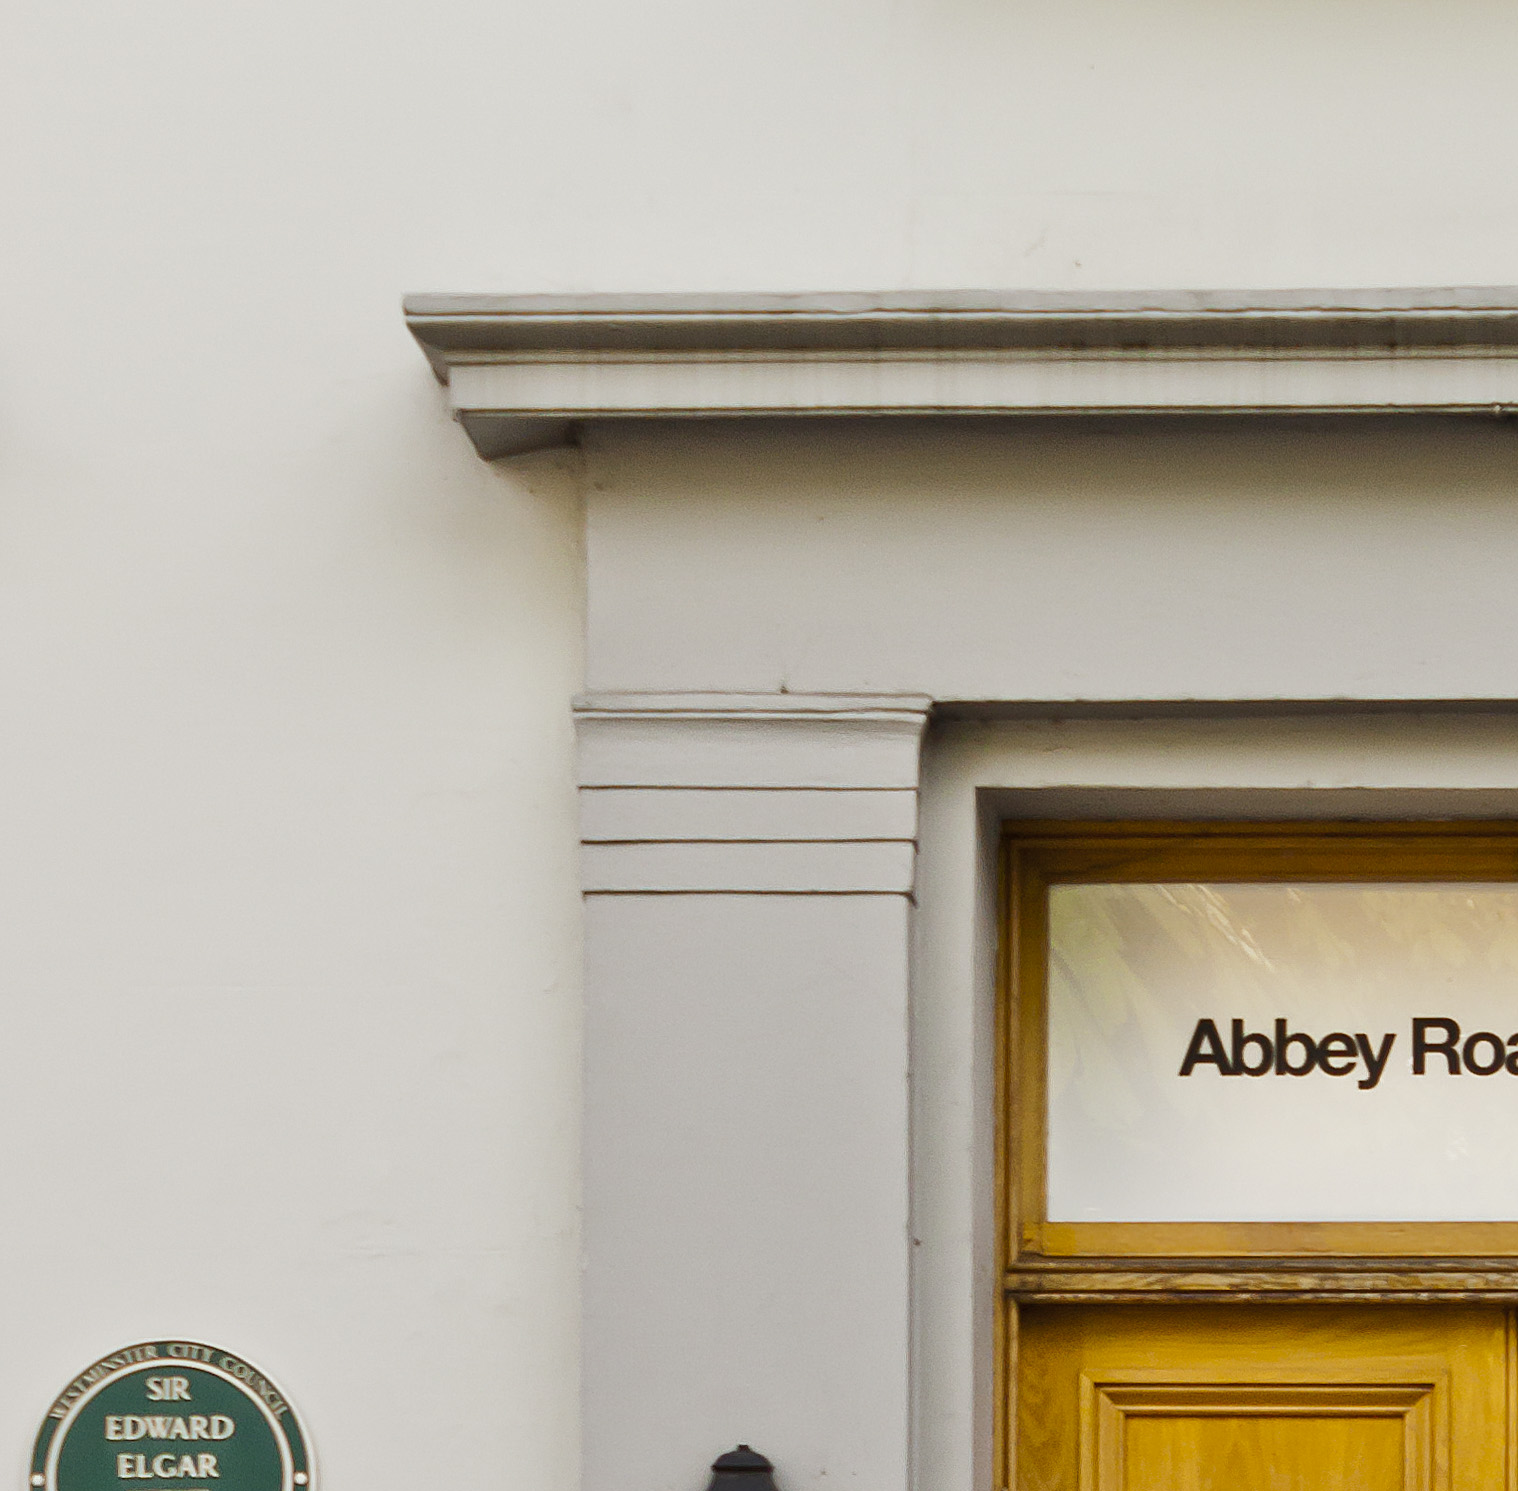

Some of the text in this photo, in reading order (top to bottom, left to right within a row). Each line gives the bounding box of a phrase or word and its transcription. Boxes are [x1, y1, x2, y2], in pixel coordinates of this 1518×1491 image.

[1179, 1016, 1396, 1091] Abbey
[144, 1376, 192, 1401] SIR
[167, 1343, 214, 1363] CITY
[218, 1355, 289, 1416] COUNCIL
[104, 1414, 235, 1441] EDWARD
[116, 1453, 221, 1478] ELGAR
